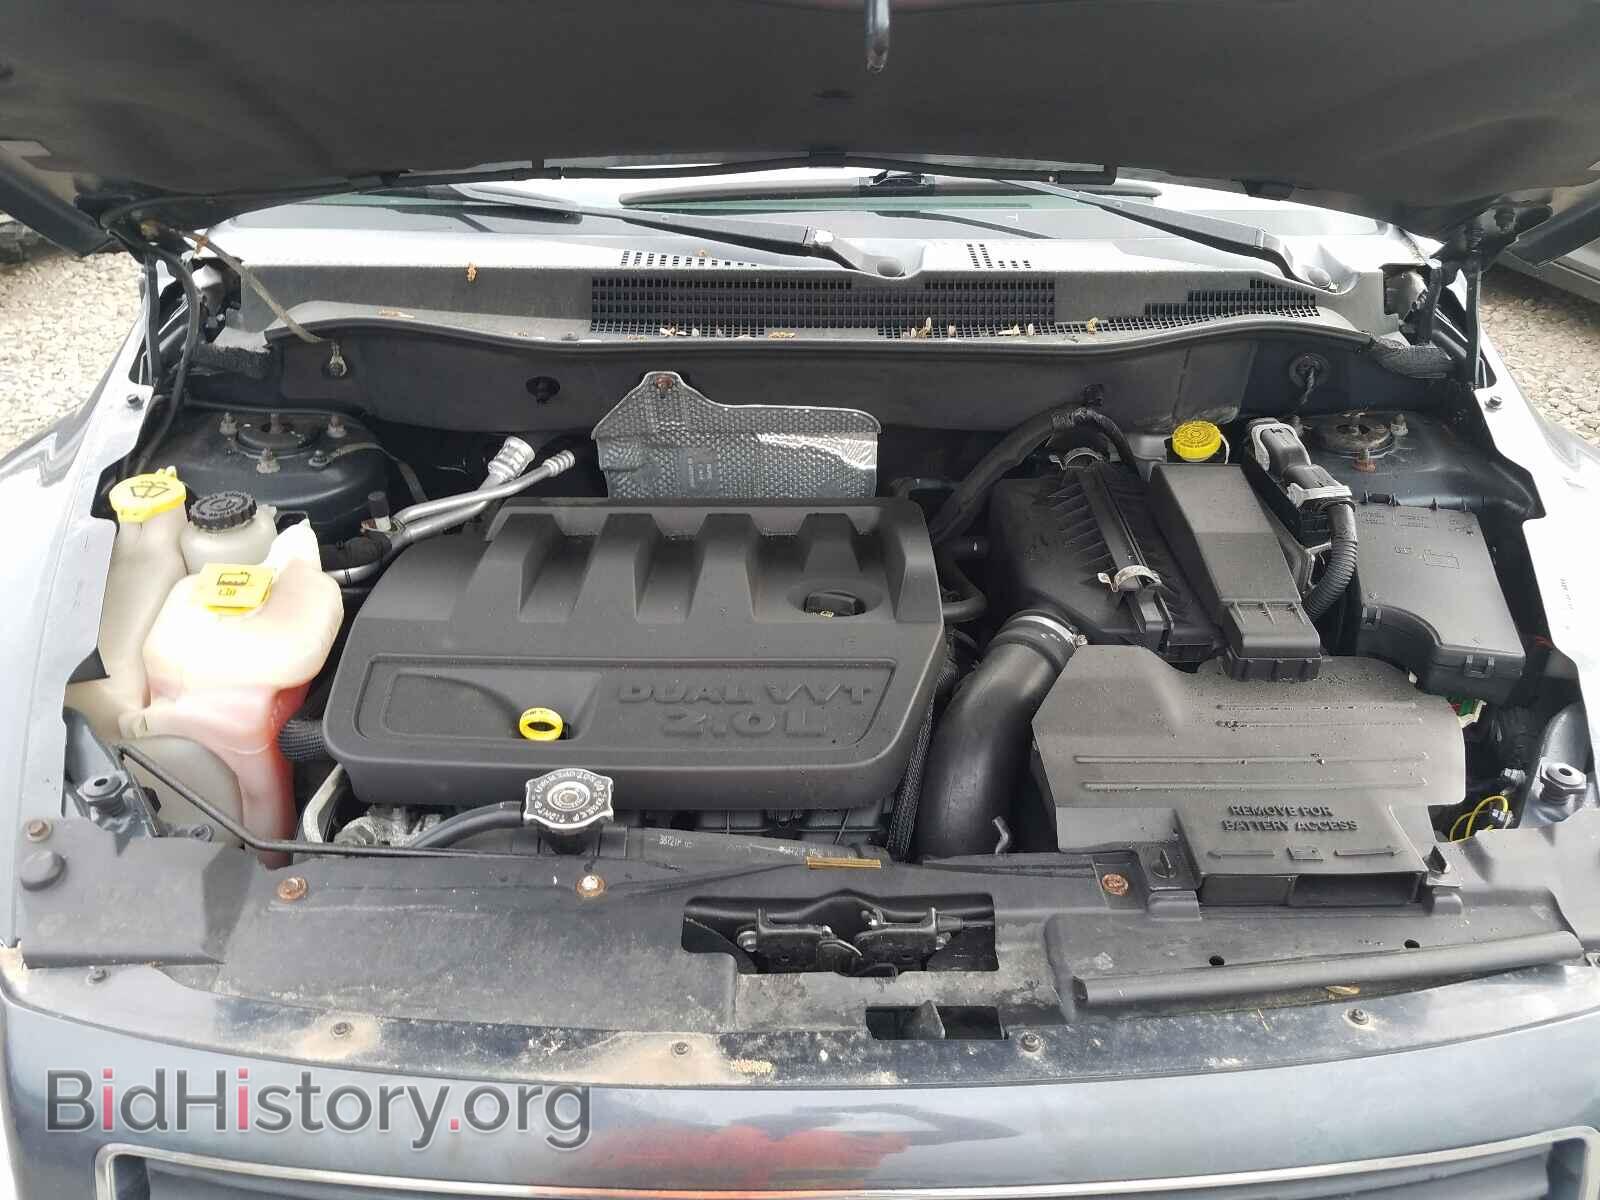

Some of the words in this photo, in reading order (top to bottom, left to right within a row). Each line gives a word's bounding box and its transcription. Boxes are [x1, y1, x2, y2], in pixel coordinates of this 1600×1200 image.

[620, 683, 754, 705] DUAL
[662, 710, 829, 738] 2.0L
[1228, 804, 1298, 817] REMOVE
[1300, 805, 1334, 817] FOR
[1222, 819, 1289, 832] BATTERY
[1295, 820, 1359, 832] ACCESS
